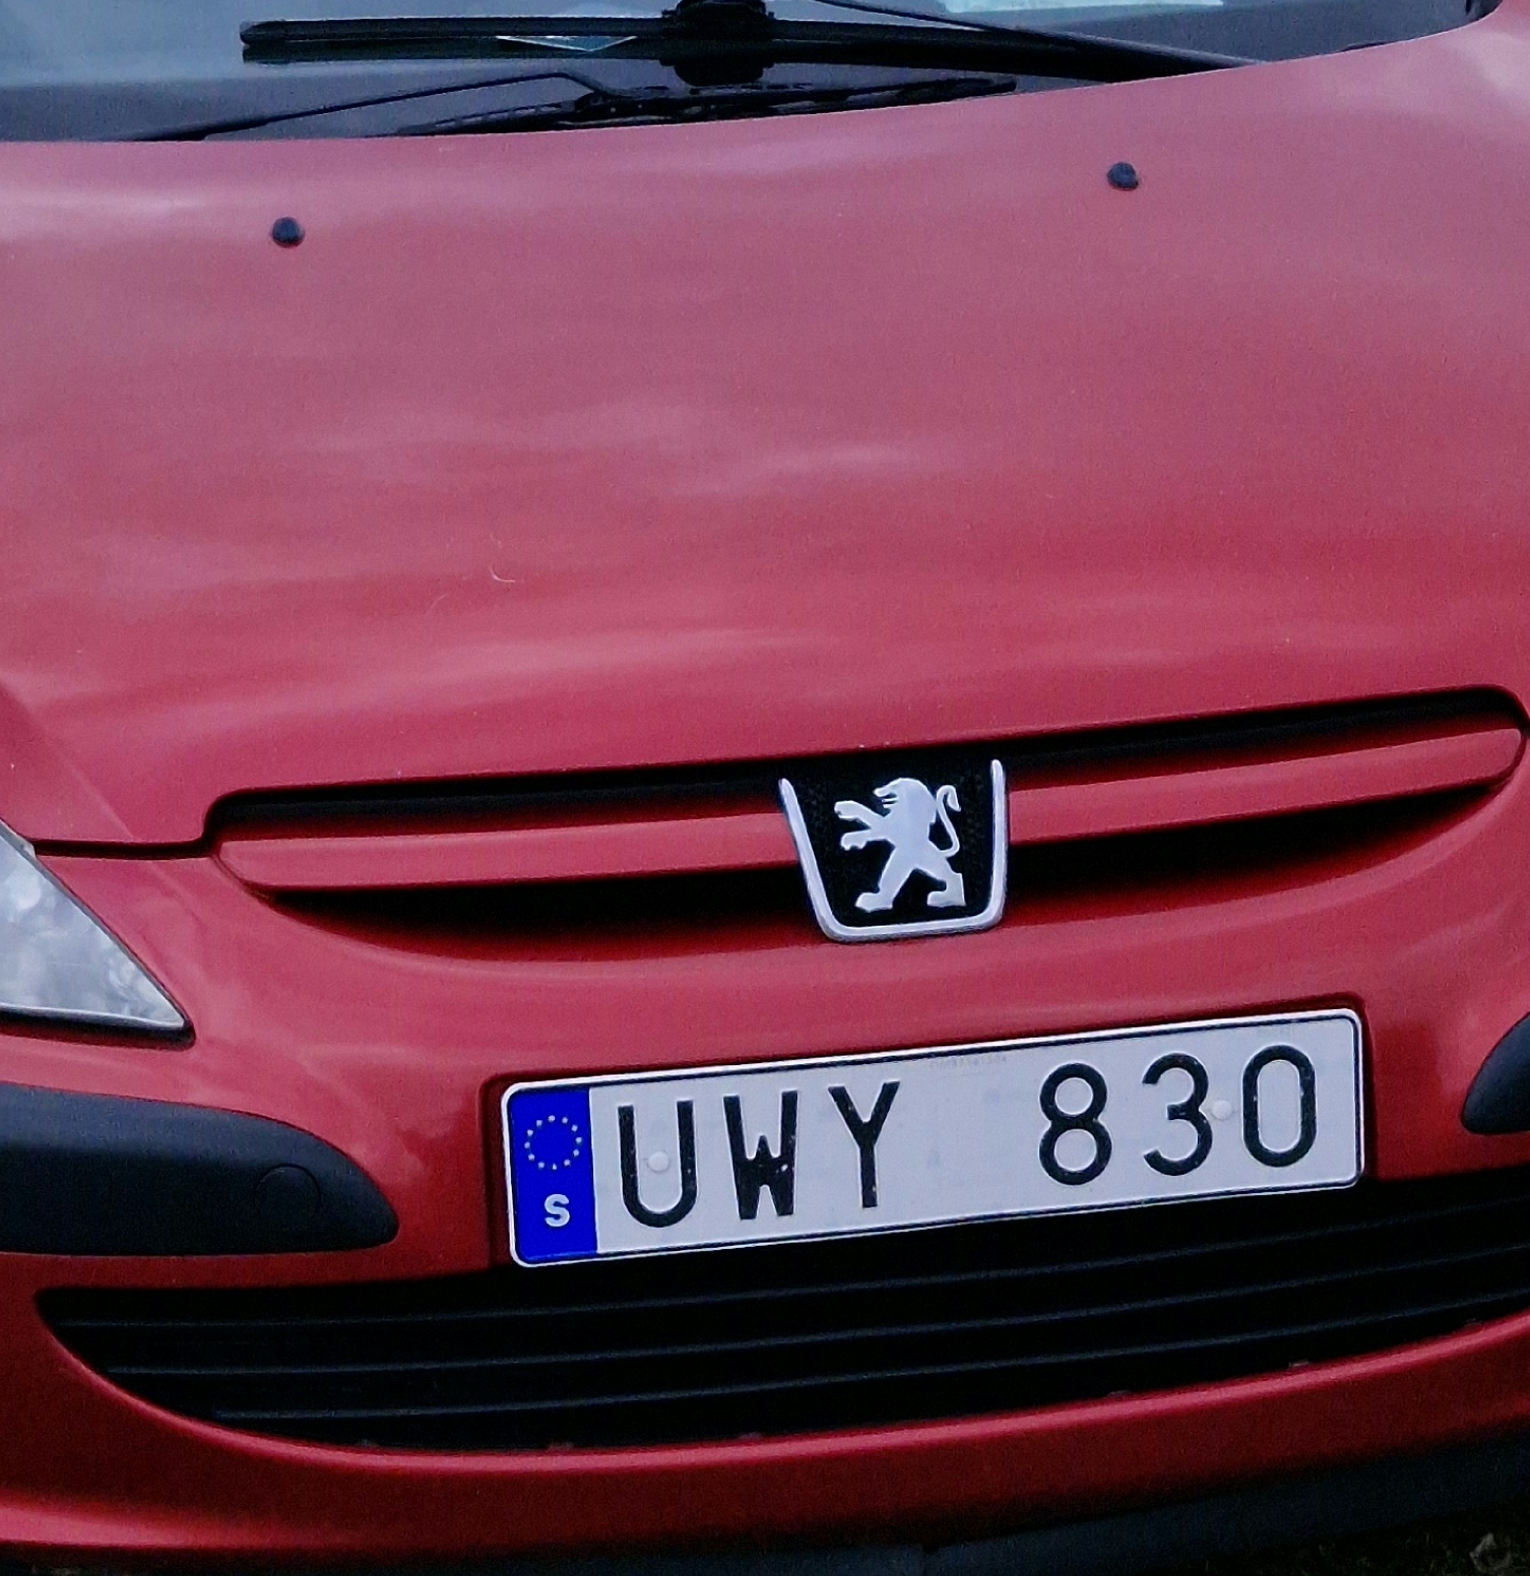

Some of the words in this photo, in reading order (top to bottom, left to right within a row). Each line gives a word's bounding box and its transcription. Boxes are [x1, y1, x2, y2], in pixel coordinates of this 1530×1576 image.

[617, 1080, 901, 1228] UWY
[1037, 1044, 1318, 1187] 830
[543, 1193, 571, 1228] S
